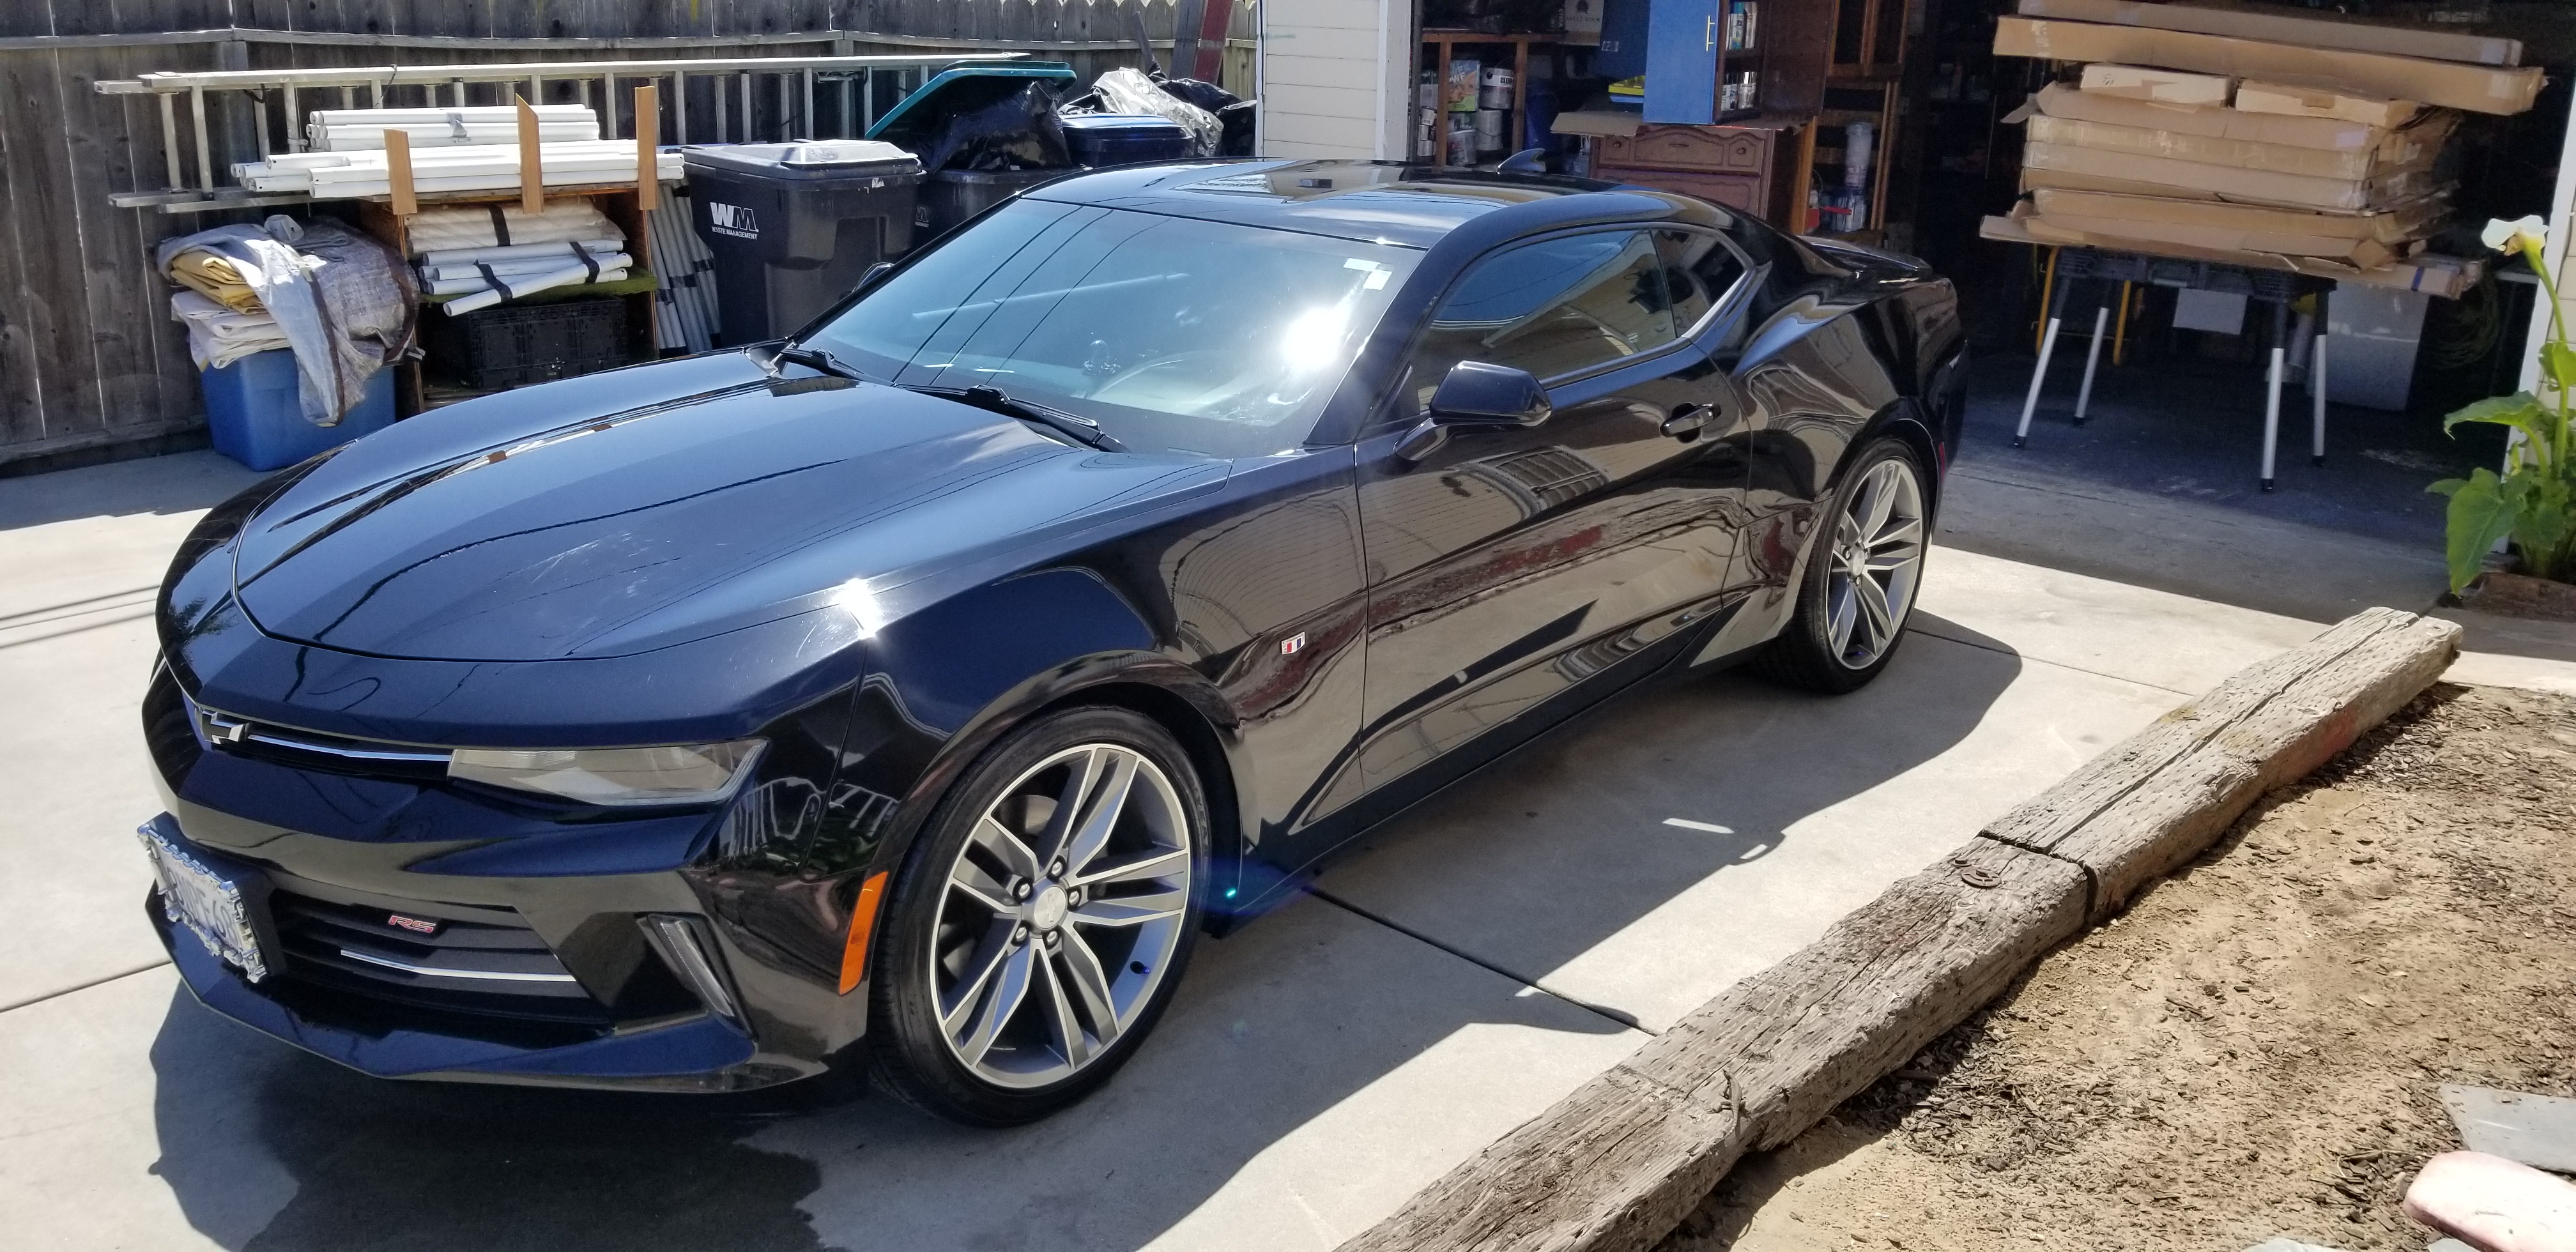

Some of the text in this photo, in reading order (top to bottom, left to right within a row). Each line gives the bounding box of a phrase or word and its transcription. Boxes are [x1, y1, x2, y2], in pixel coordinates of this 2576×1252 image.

[709, 201, 759, 233] WM
[712, 225, 758, 240] WASTE MANAGEMENT
[388, 915, 436, 933] RS
